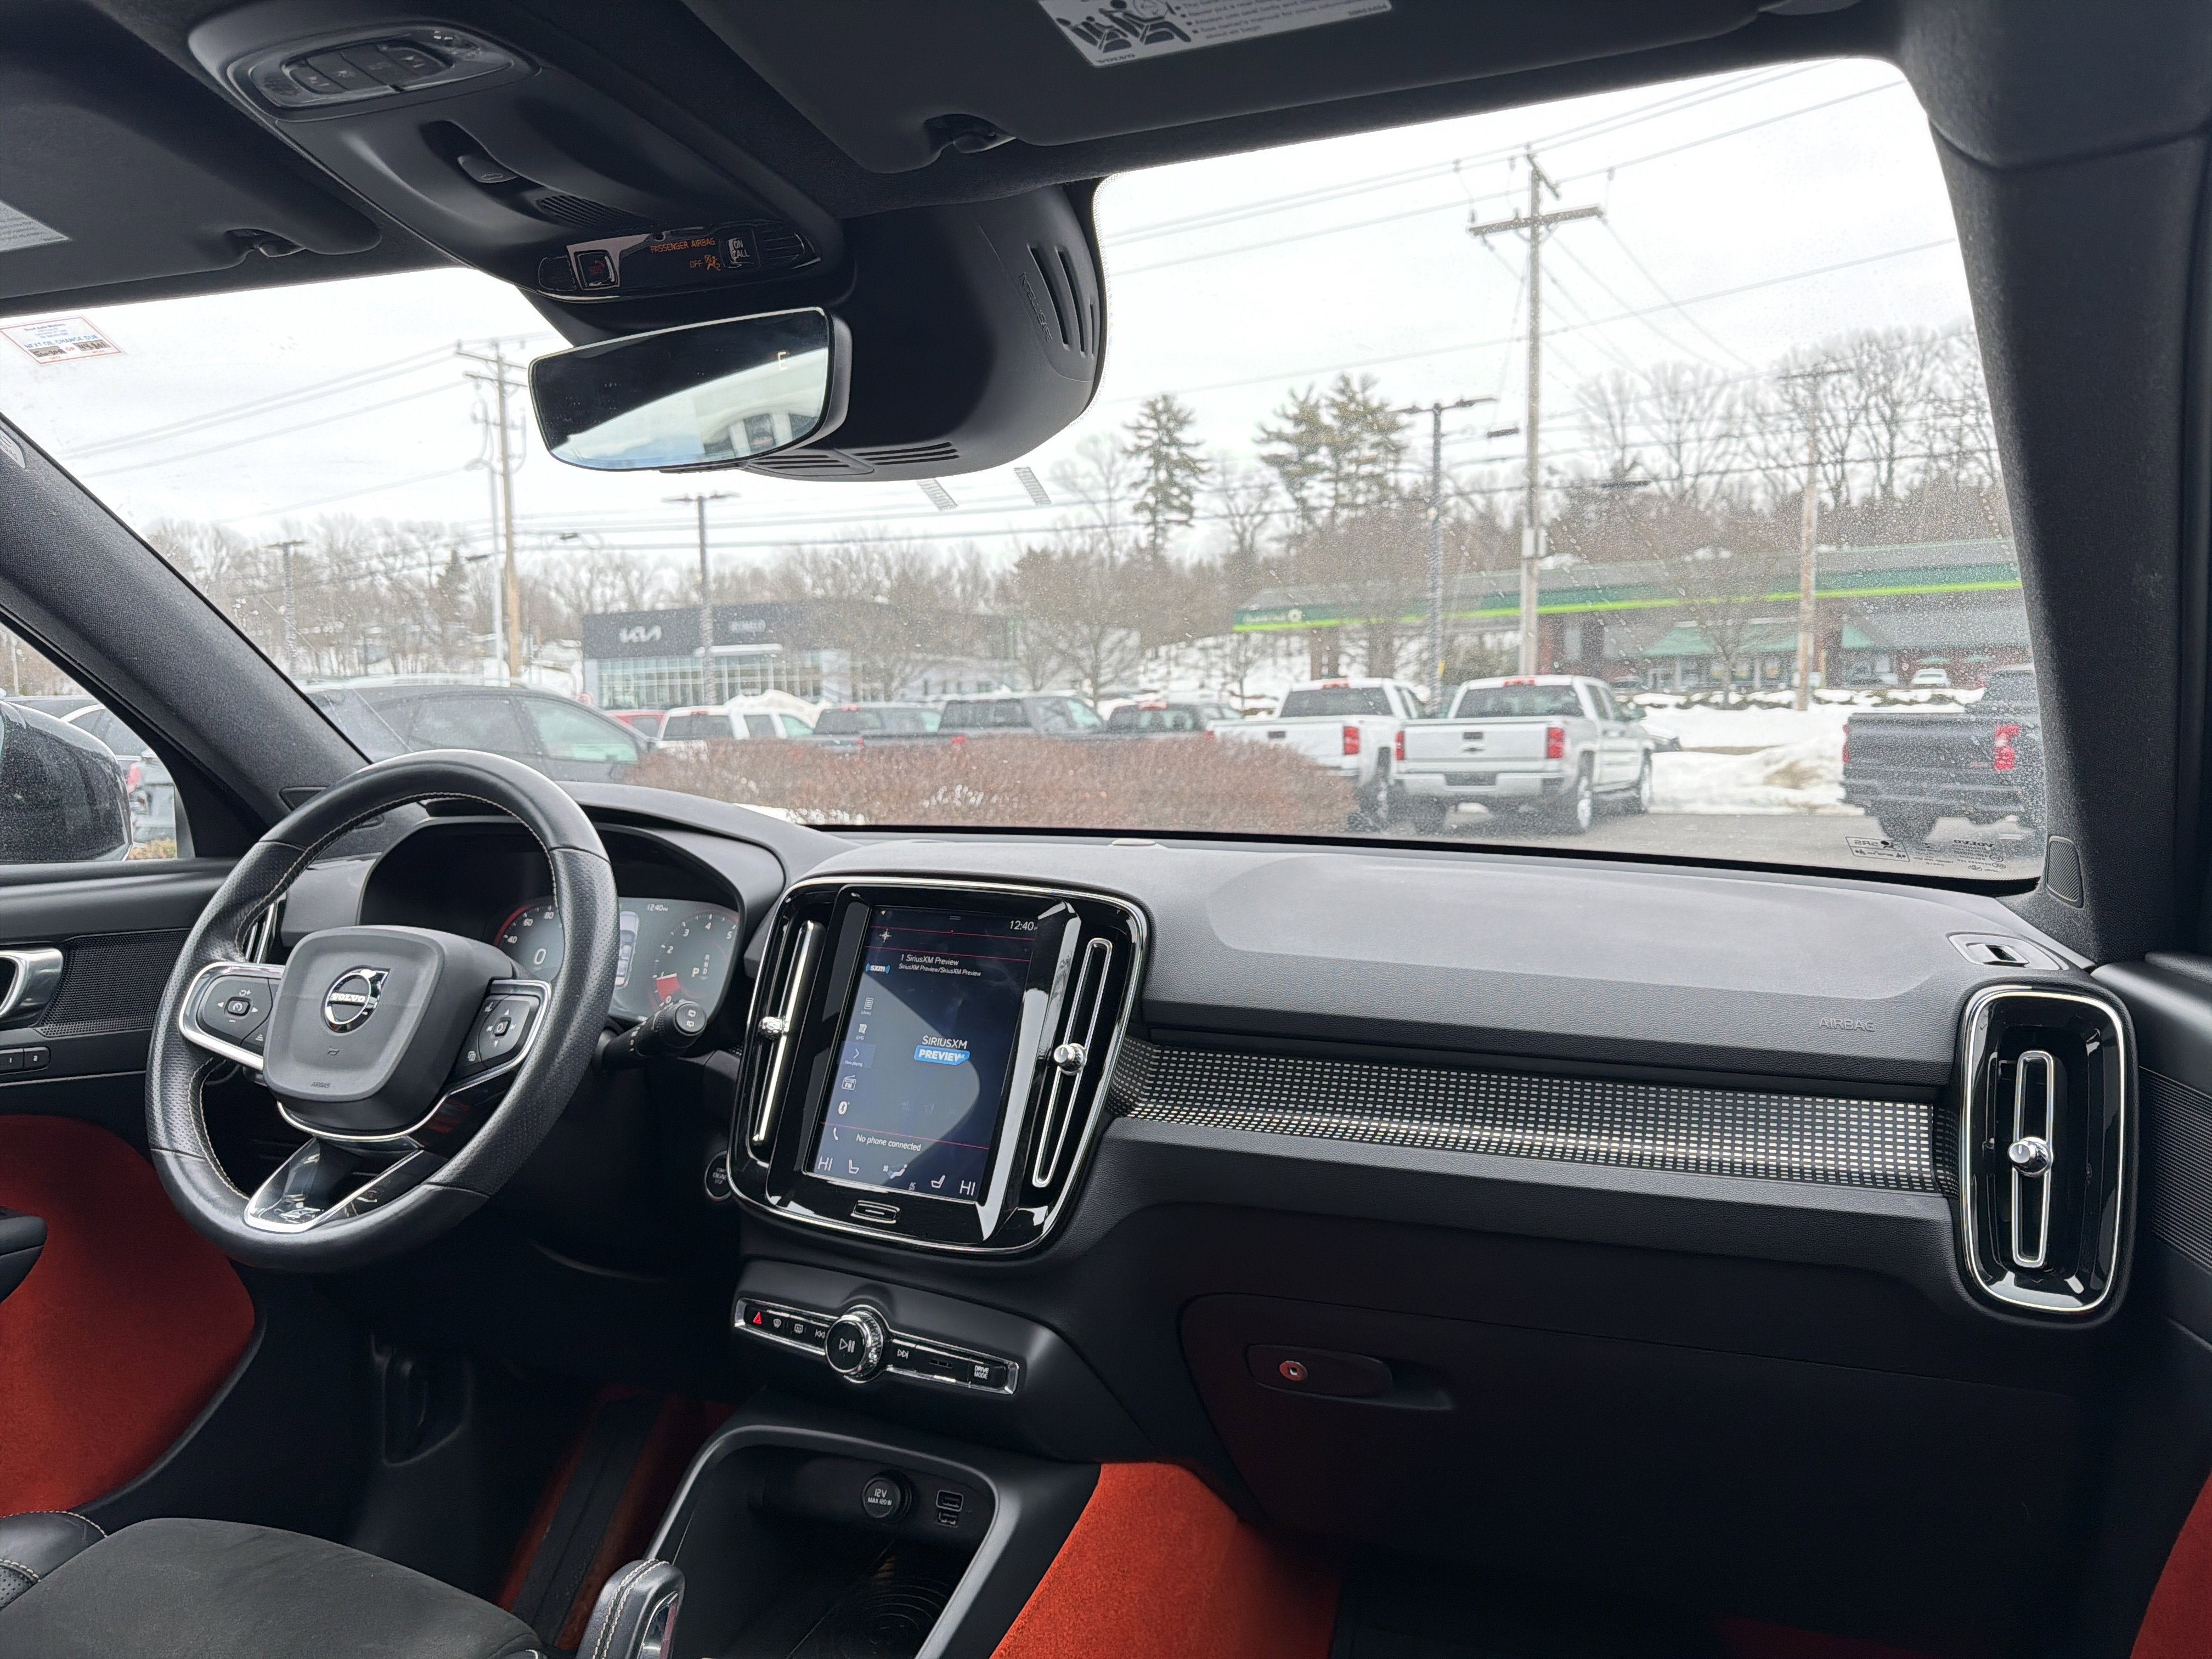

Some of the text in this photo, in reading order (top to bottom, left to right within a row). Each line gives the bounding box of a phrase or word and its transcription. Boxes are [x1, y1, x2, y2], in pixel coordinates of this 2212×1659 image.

[651, 238, 716, 253] PASSENGER AIRBAG
[733, 239, 744, 249] ON
[732, 249, 751, 259] CALL
[690, 260, 703, 269] OFF
[55, 336, 83, 345] CHANGE
[619, 625, 662, 643] KIA
[544, 911, 554, 919] 80
[523, 918, 533, 927] 60
[683, 928, 690, 938] 3
[726, 931, 733, 939] 5
[507, 935, 518, 944] 40
[667, 945, 674, 954] 2
[534, 948, 546, 966] 0
[906, 954, 934, 964] SiriusXM
[934, 956, 959, 966] Preview
[898, 963, 919, 971] SiriusXM
[691, 967, 699, 978] P
[330, 992, 366, 1003] VOLVO
[665, 995, 672, 1003] 0
[1818, 1018, 1876, 1032] AIRBAG
[922, 1035, 968, 1049] SIRIUSXM
[918, 1049, 966, 1062] PREVIEW
[856, 1133, 922, 1152] No phone connected
[817, 1156, 833, 1171] HI
[960, 1180, 976, 1196] HI
[974, 1365, 990, 1373] DRIVE
[974, 1371, 988, 1379] MODE
